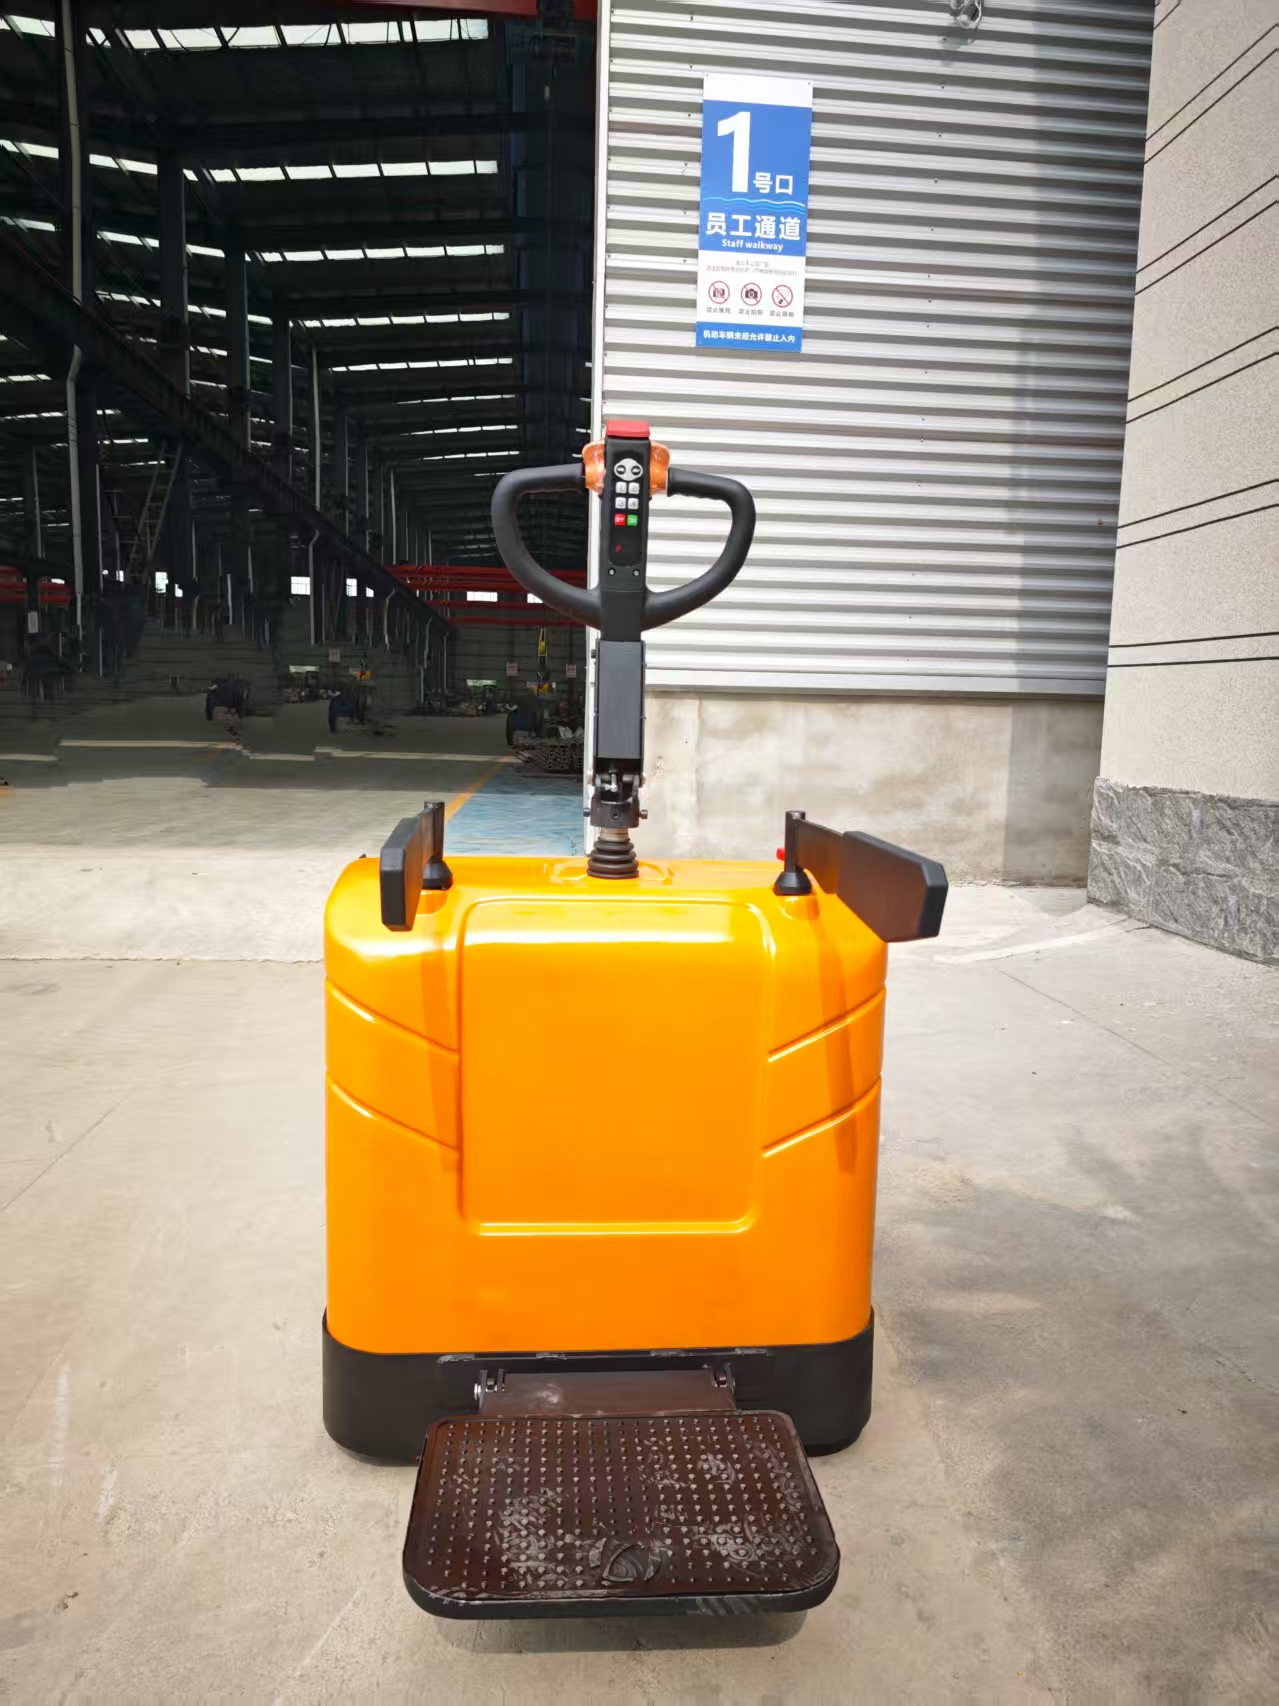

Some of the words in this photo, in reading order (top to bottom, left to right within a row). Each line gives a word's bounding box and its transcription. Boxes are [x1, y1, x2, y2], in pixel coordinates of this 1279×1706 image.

[706, 212, 801, 241] 员工通道
[722, 239, 744, 248] Staff
[745, 241, 783, 252] walkway
[704, 330, 795, 343] 机动车辆未经允许禁止入内
